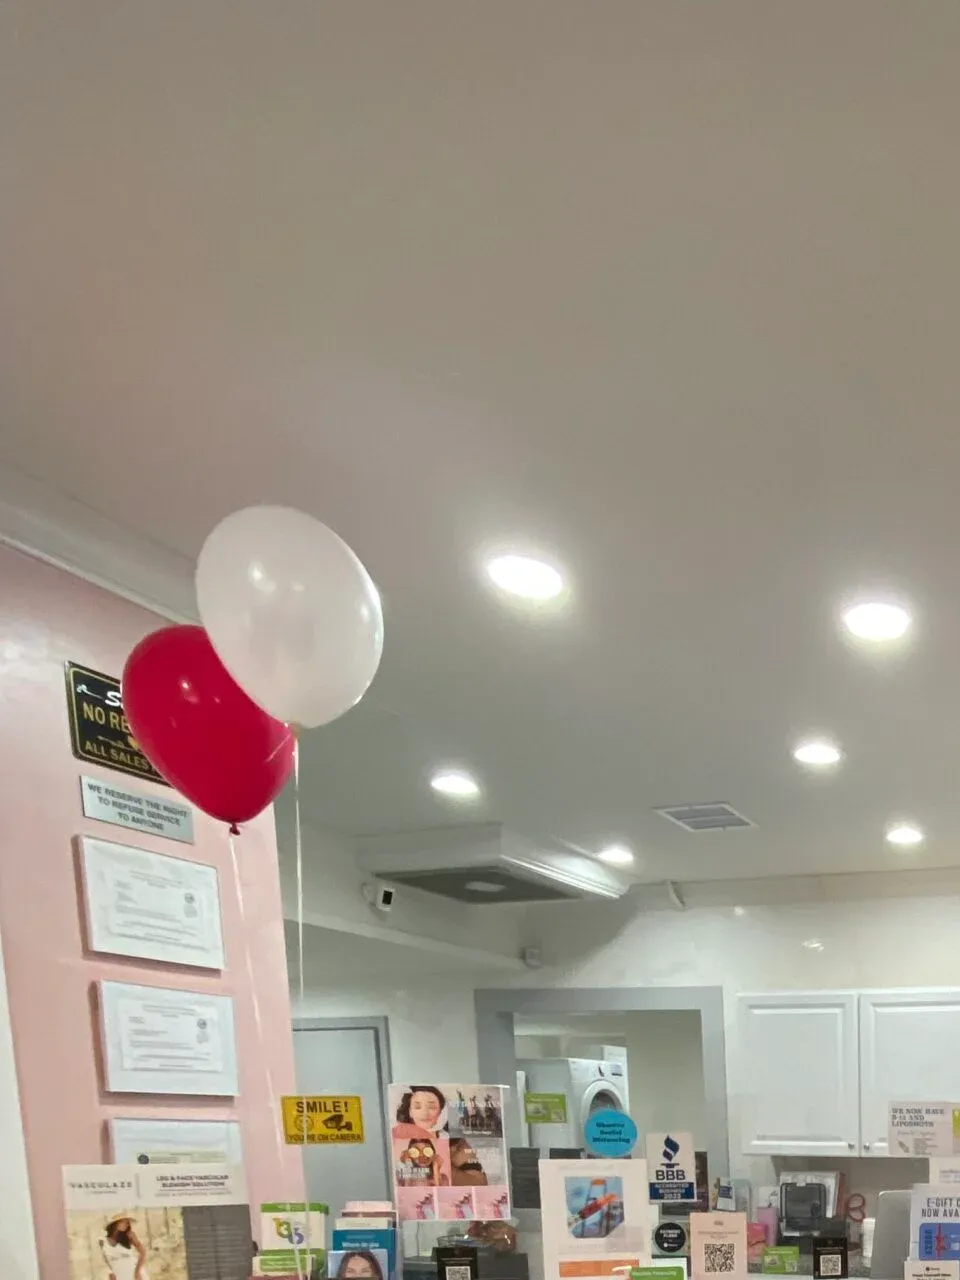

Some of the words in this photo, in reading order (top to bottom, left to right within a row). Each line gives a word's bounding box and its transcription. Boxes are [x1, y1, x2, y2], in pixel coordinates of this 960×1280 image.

[82, 701, 106, 725] NO
[85, 740, 107, 757] ALL
[111, 750, 149, 770] SALES
[88, 783, 102, 794] WE
[104, 787, 142, 805] RESERVE
[146, 798, 160, 811] THE
[163, 804, 188, 817] RIGHT
[97, 795, 110, 807] TO
[111, 800, 145, 817] REFUSE
[147, 811, 181, 826] SERVICE
[118, 812, 129, 821] TO
[131, 815, 164, 831] ANYONE
[655, 1169, 686, 1180] BBB
[922, 1208, 940, 1218] NOW
[927, 1198, 953, 1208] E-GIFT
